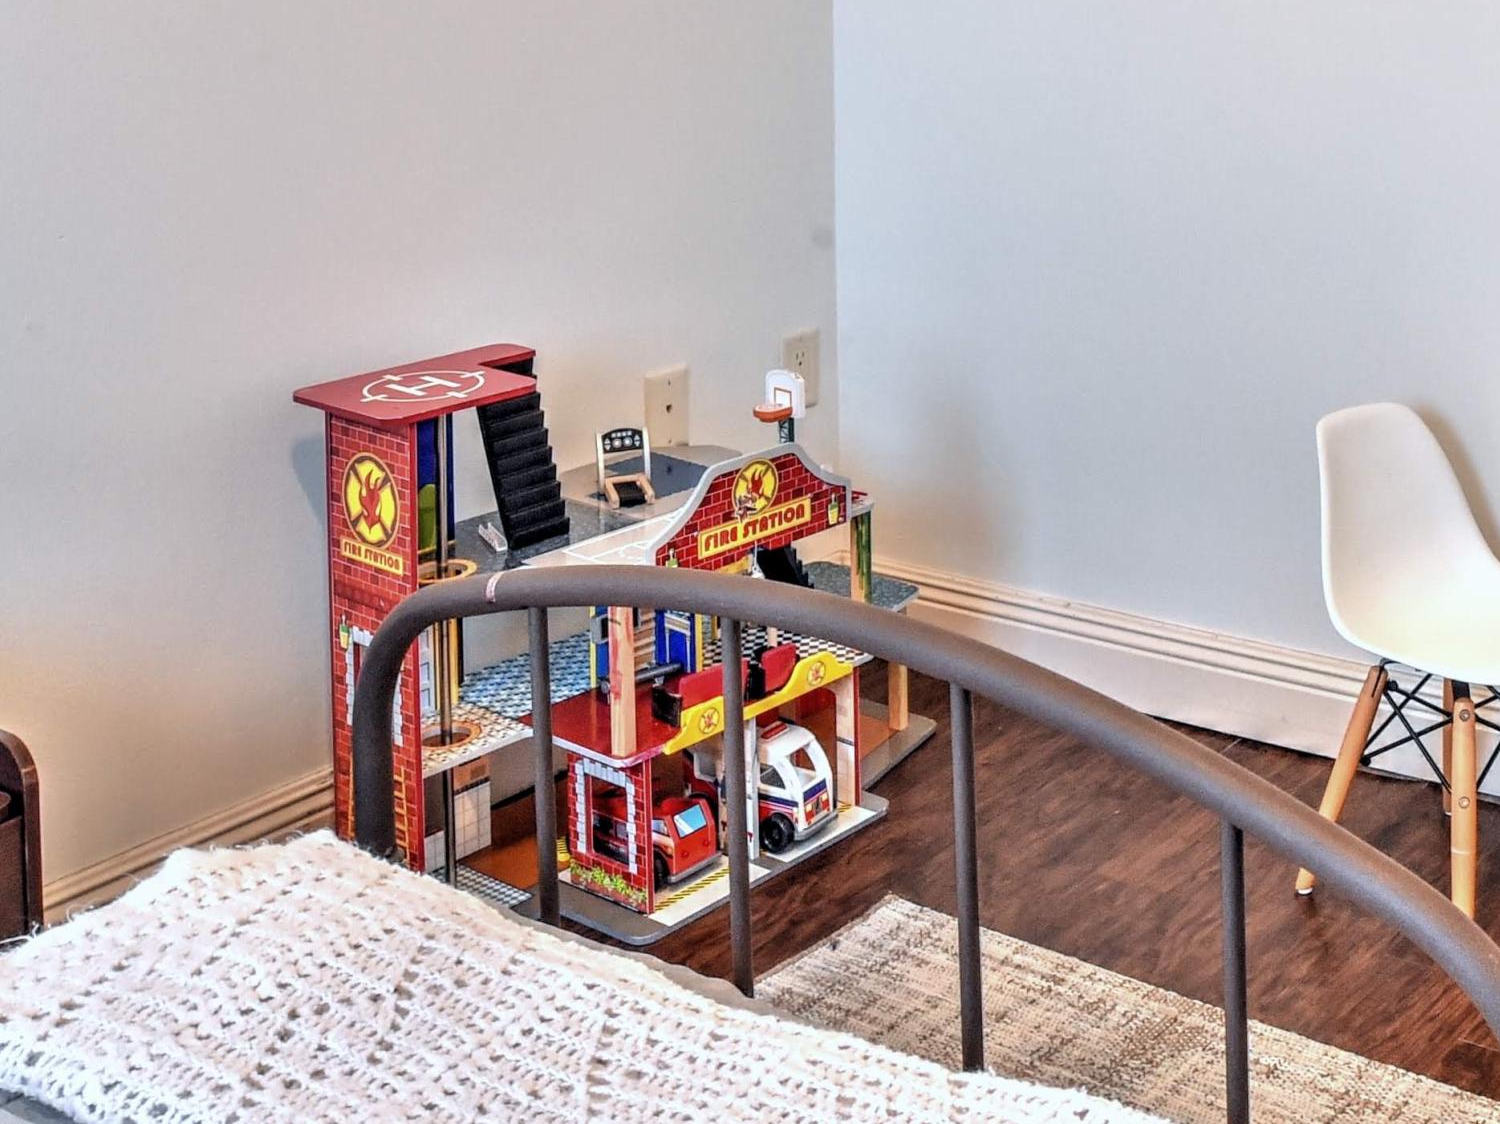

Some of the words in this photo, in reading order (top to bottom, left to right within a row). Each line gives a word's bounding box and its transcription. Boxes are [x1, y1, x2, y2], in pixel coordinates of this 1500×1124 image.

[384, 375, 462, 396] H
[704, 525, 739, 552] FIRE
[742, 503, 805, 539] STATION
[344, 541, 362, 558] FIRE
